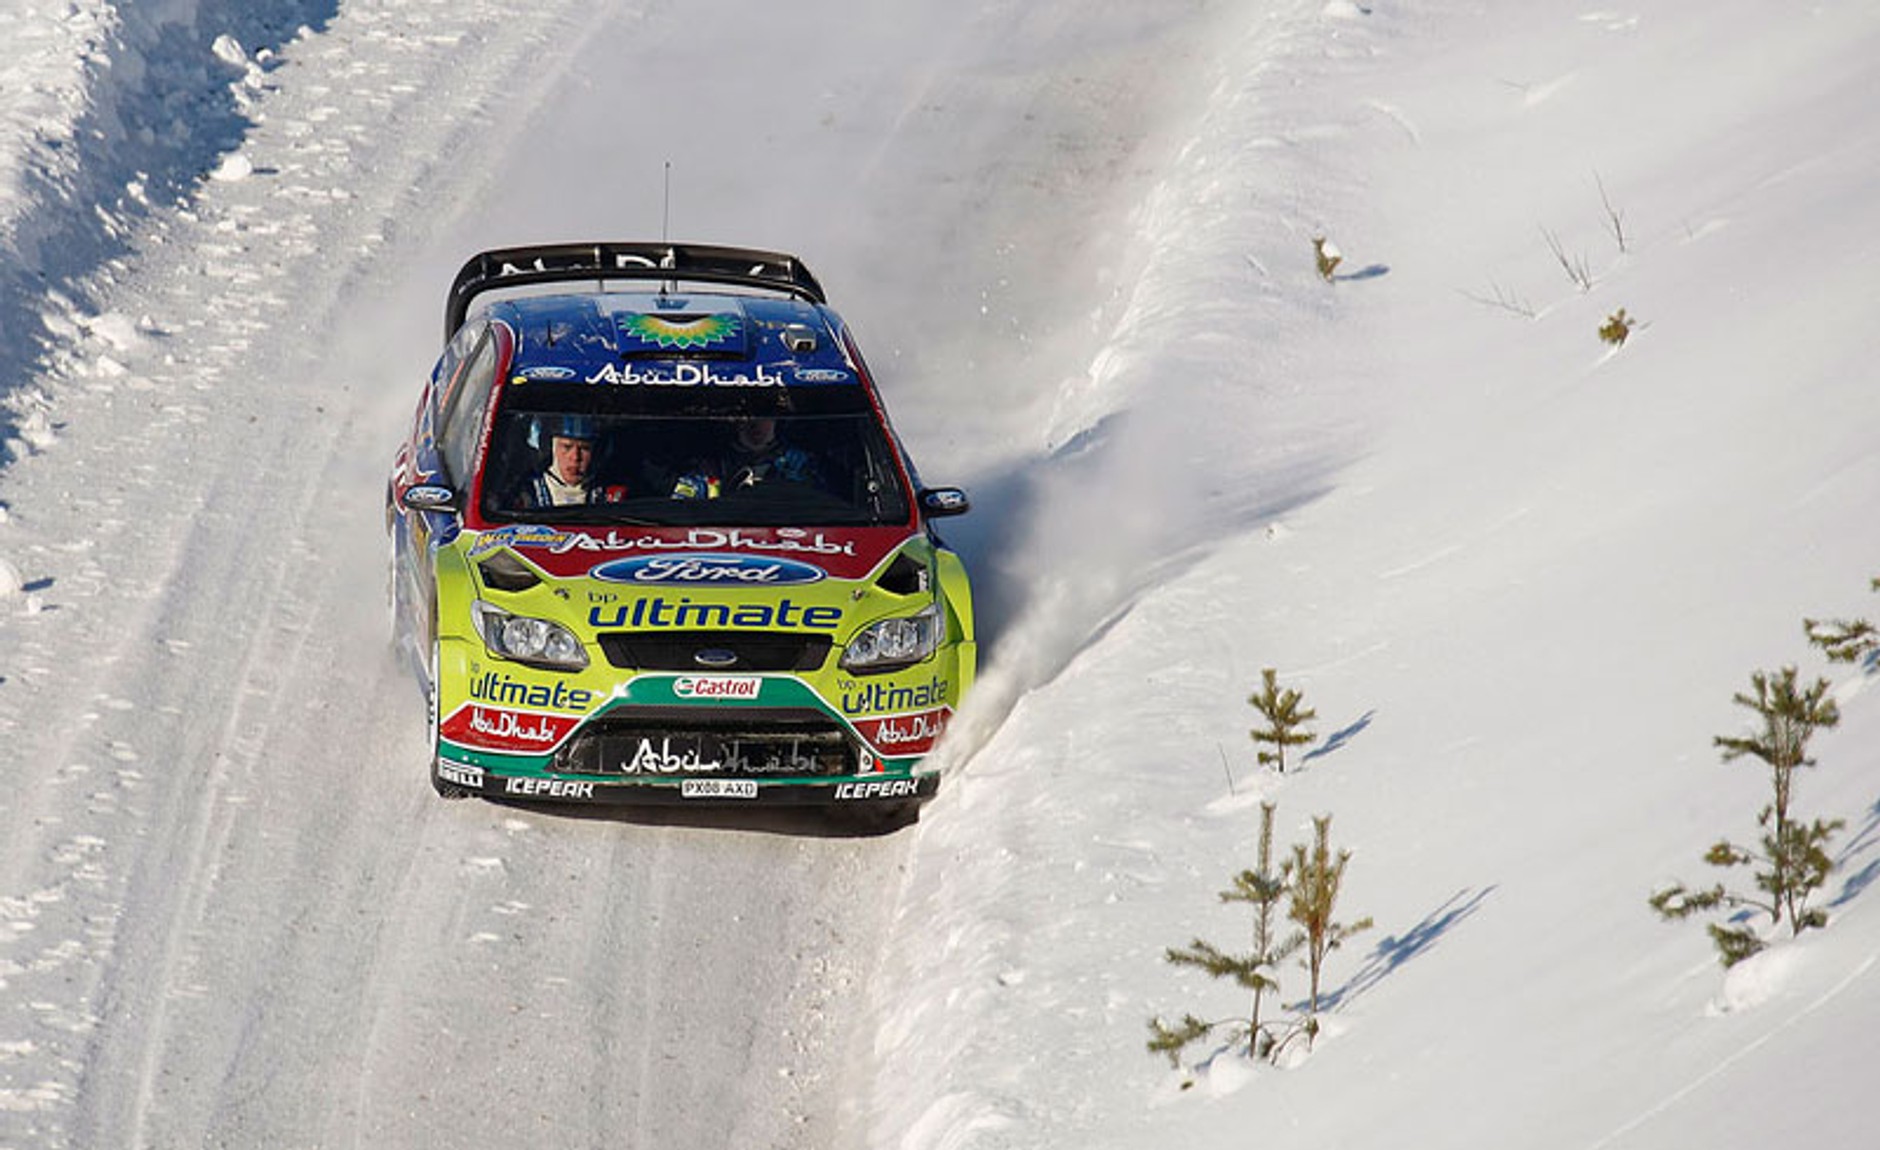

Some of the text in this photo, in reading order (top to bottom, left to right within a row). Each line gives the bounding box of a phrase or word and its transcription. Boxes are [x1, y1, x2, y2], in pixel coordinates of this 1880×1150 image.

[634, 558, 783, 582] Ford
[588, 591, 618, 604] bp
[587, 597, 843, 629] ultimate
[470, 672, 592, 711] ultimate
[694, 678, 757, 696] Castrol
[842, 676, 948, 714] ultimate
[505, 777, 595, 799] ICEPEAK
[834, 779, 919, 800] ICEPEAK
